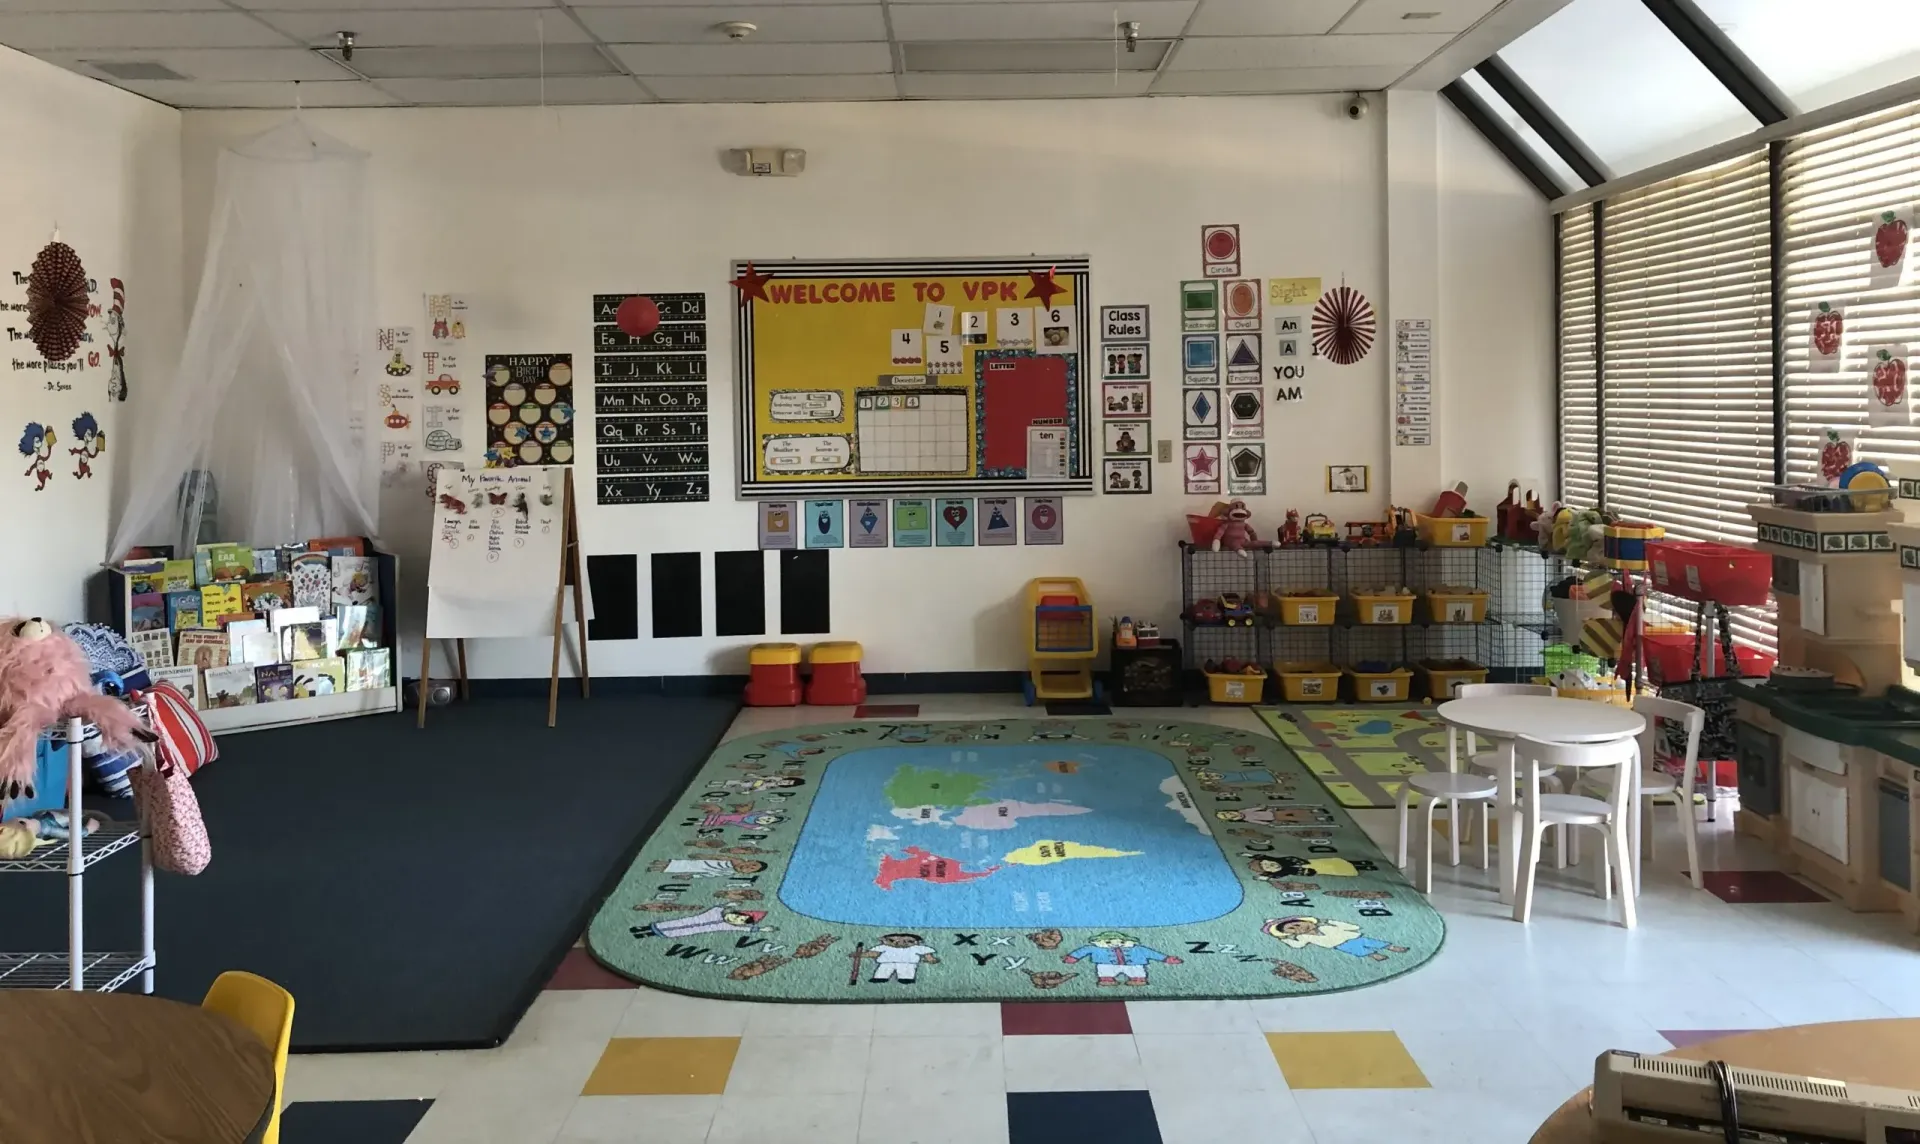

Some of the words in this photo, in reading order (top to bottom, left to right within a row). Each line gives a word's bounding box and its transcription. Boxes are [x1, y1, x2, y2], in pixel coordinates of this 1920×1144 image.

[770, 282, 895, 304] WELCOME
[913, 282, 945, 302] TO
[962, 281, 1017, 301] VPK
[1271, 282, 1307, 303] Sight
[656, 302, 671, 314] Cc
[682, 301, 699, 313] Dd
[971, 316, 978, 328] 2
[1011, 313, 1020, 326] 3
[1051, 310, 1060, 322] 6
[1109, 310, 1141, 322] Class
[1109, 324, 1141, 335] Rules
[1235, 320, 1251, 328] Oval
[1282, 320, 1297, 330] An
[601, 333, 616, 345] Ee
[653, 332, 673, 347] Gg
[683, 332, 700, 344] Hh
[902, 333, 910, 344] 4
[940, 341, 949, 353] 5
[1284, 343, 1293, 353] A
[423, 352, 439, 374] T
[509, 357, 551, 367] HAPPY
[516, 366, 544, 377] BIRTH
[602, 363, 613, 376] Ii
[628, 363, 639, 378] Jj
[656, 362, 673, 375] Kk
[689, 362, 700, 374] Ll
[1274, 366, 1304, 379] YOU
[1187, 375, 1215, 384] Square
[603, 395, 625, 406] Mm
[633, 394, 651, 405] Nn
[659, 393, 678, 405] Oo
[687, 393, 701, 407] Pp
[1277, 387, 1302, 401] AM
[603, 424, 624, 441] Qq
[635, 424, 648, 436] Rr
[662, 423, 676, 435] Ss
[690, 423, 701, 435] Tt
[1039, 432, 1054, 440] ten
[604, 455, 620, 466] Uu
[642, 453, 658, 465] Vv
[678, 453, 702, 464] Ww
[462, 475, 475, 487] My
[605, 485, 622, 497] Xx
[646, 484, 661, 500] Yy
[686, 483, 703, 495] Zz
[218, 553, 236, 561] EAR
